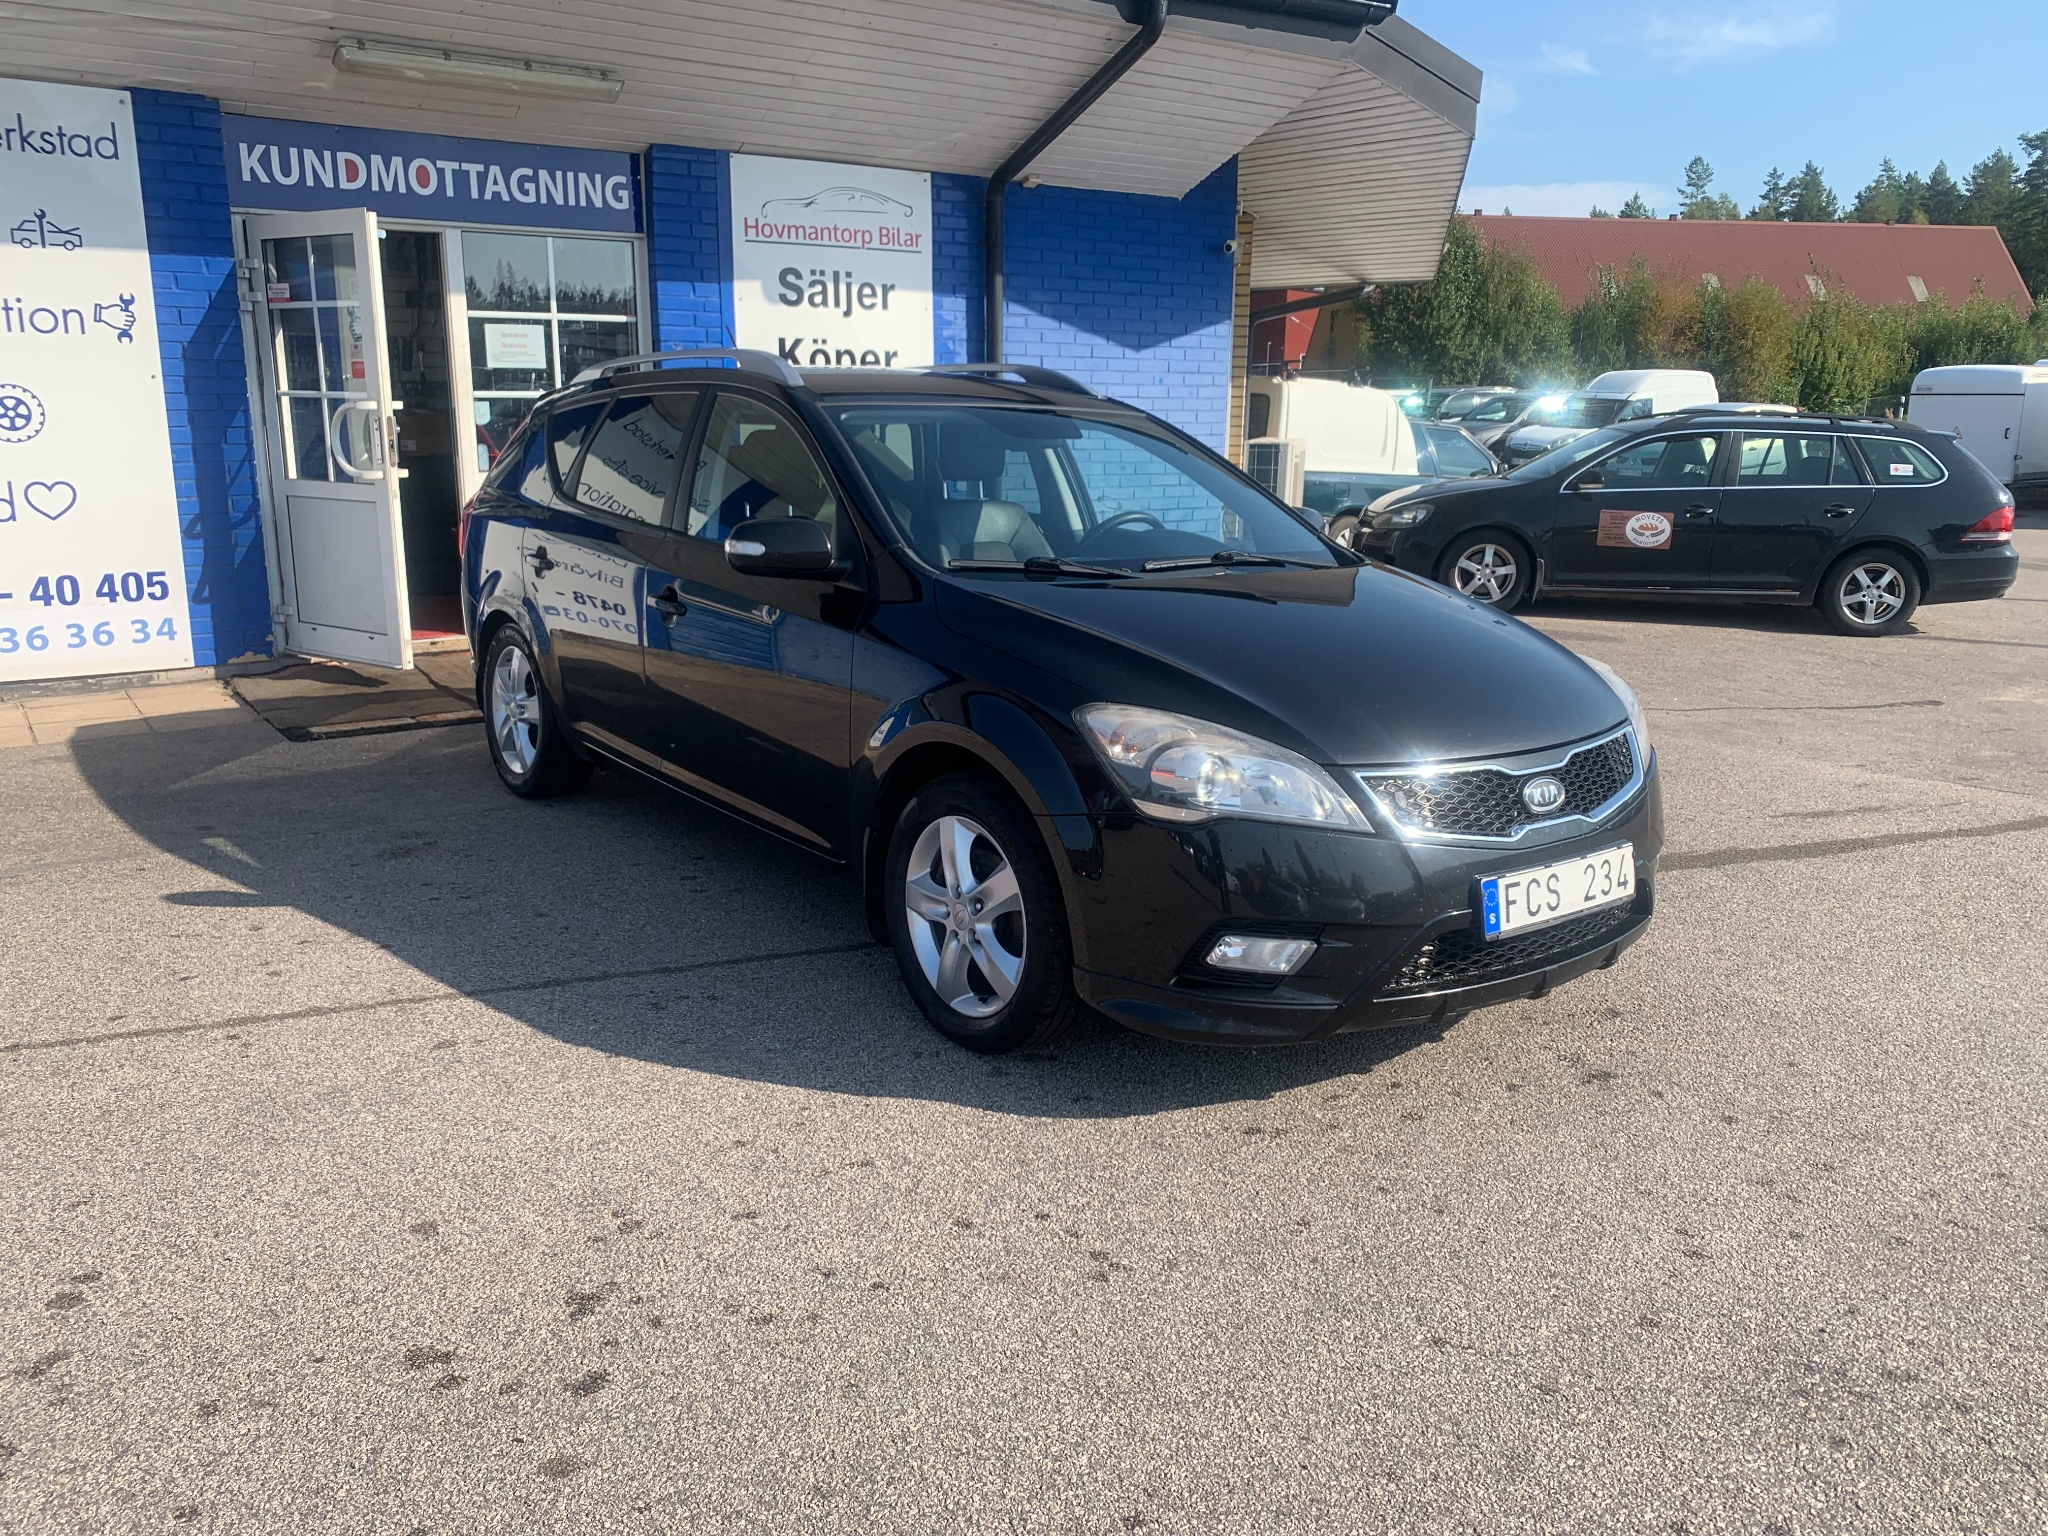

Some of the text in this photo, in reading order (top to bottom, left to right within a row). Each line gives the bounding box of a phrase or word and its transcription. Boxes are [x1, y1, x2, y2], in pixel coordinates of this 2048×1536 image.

[0, 112, 119, 160] rkstad
[238, 142, 631, 211] KUNDMOTTAGNING
[744, 217, 923, 249] Hovmantorp Bilar
[778, 267, 896, 318] Säljer
[1635, 514, 1665, 524] HOVETS
[29, 574, 81, 607] 40
[95, 571, 170, 603] 405
[65, 621, 115, 649] 36
[130, 617, 178, 644] 34
[1531, 786, 1558, 804] KIA
[1504, 853, 1629, 924] FCS 234
[1489, 912, 1497, 925] S
